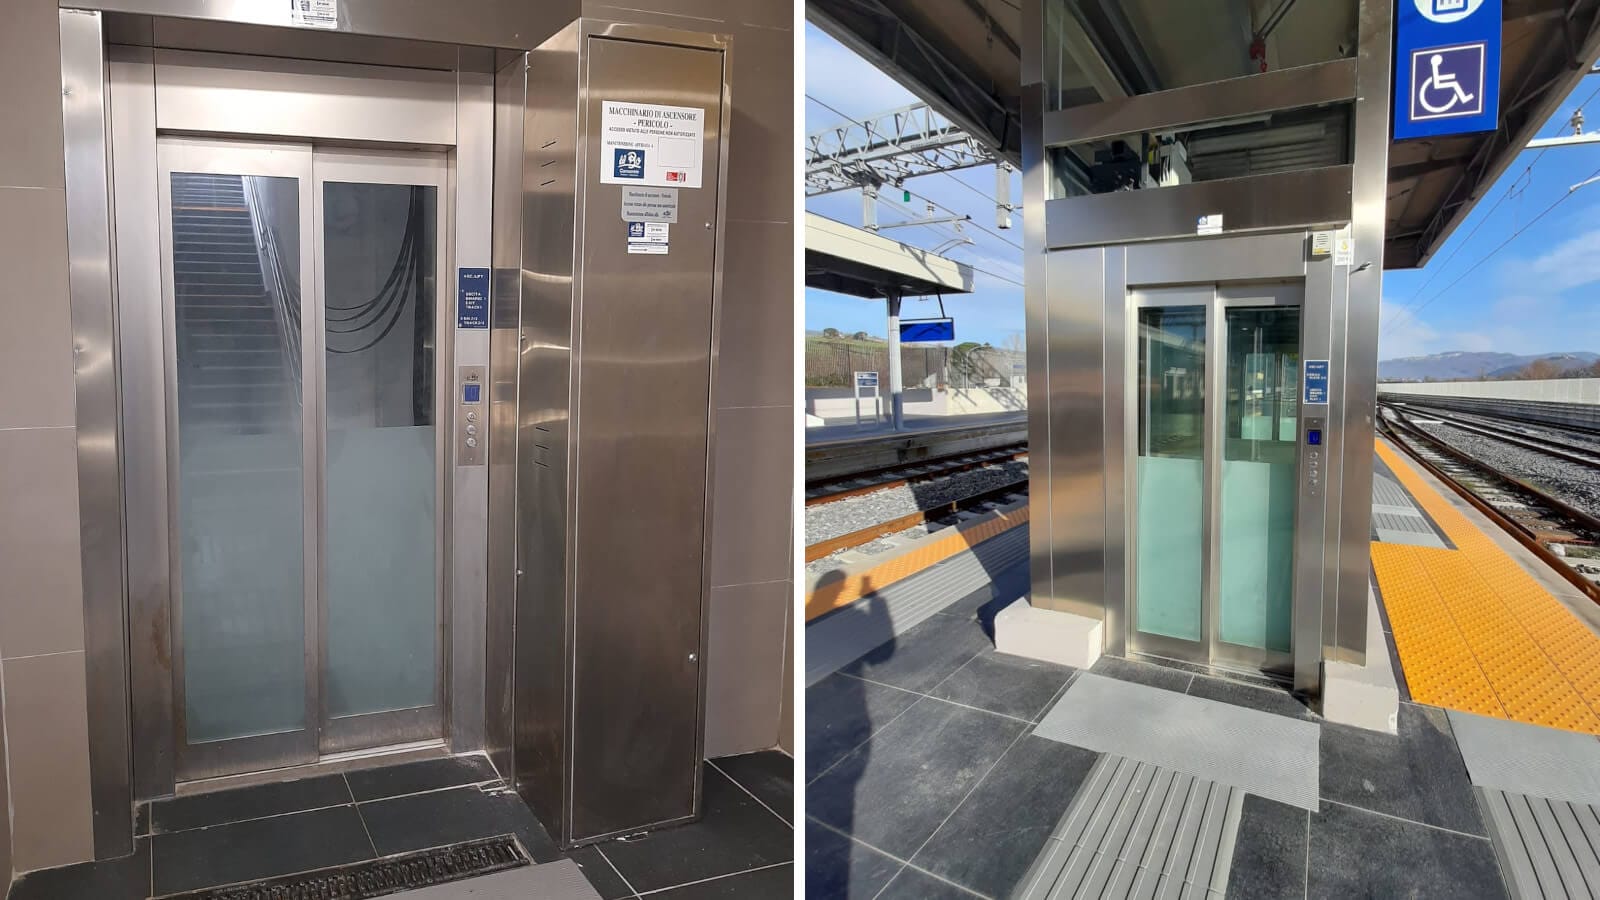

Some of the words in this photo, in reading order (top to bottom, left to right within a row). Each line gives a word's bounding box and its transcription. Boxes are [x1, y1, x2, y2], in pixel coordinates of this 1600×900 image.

[609, 107, 653, 119] MACCHINARIO
[662, 111, 697, 121] ASCENSORE
[637, 119, 669, 129] PERICOLO
